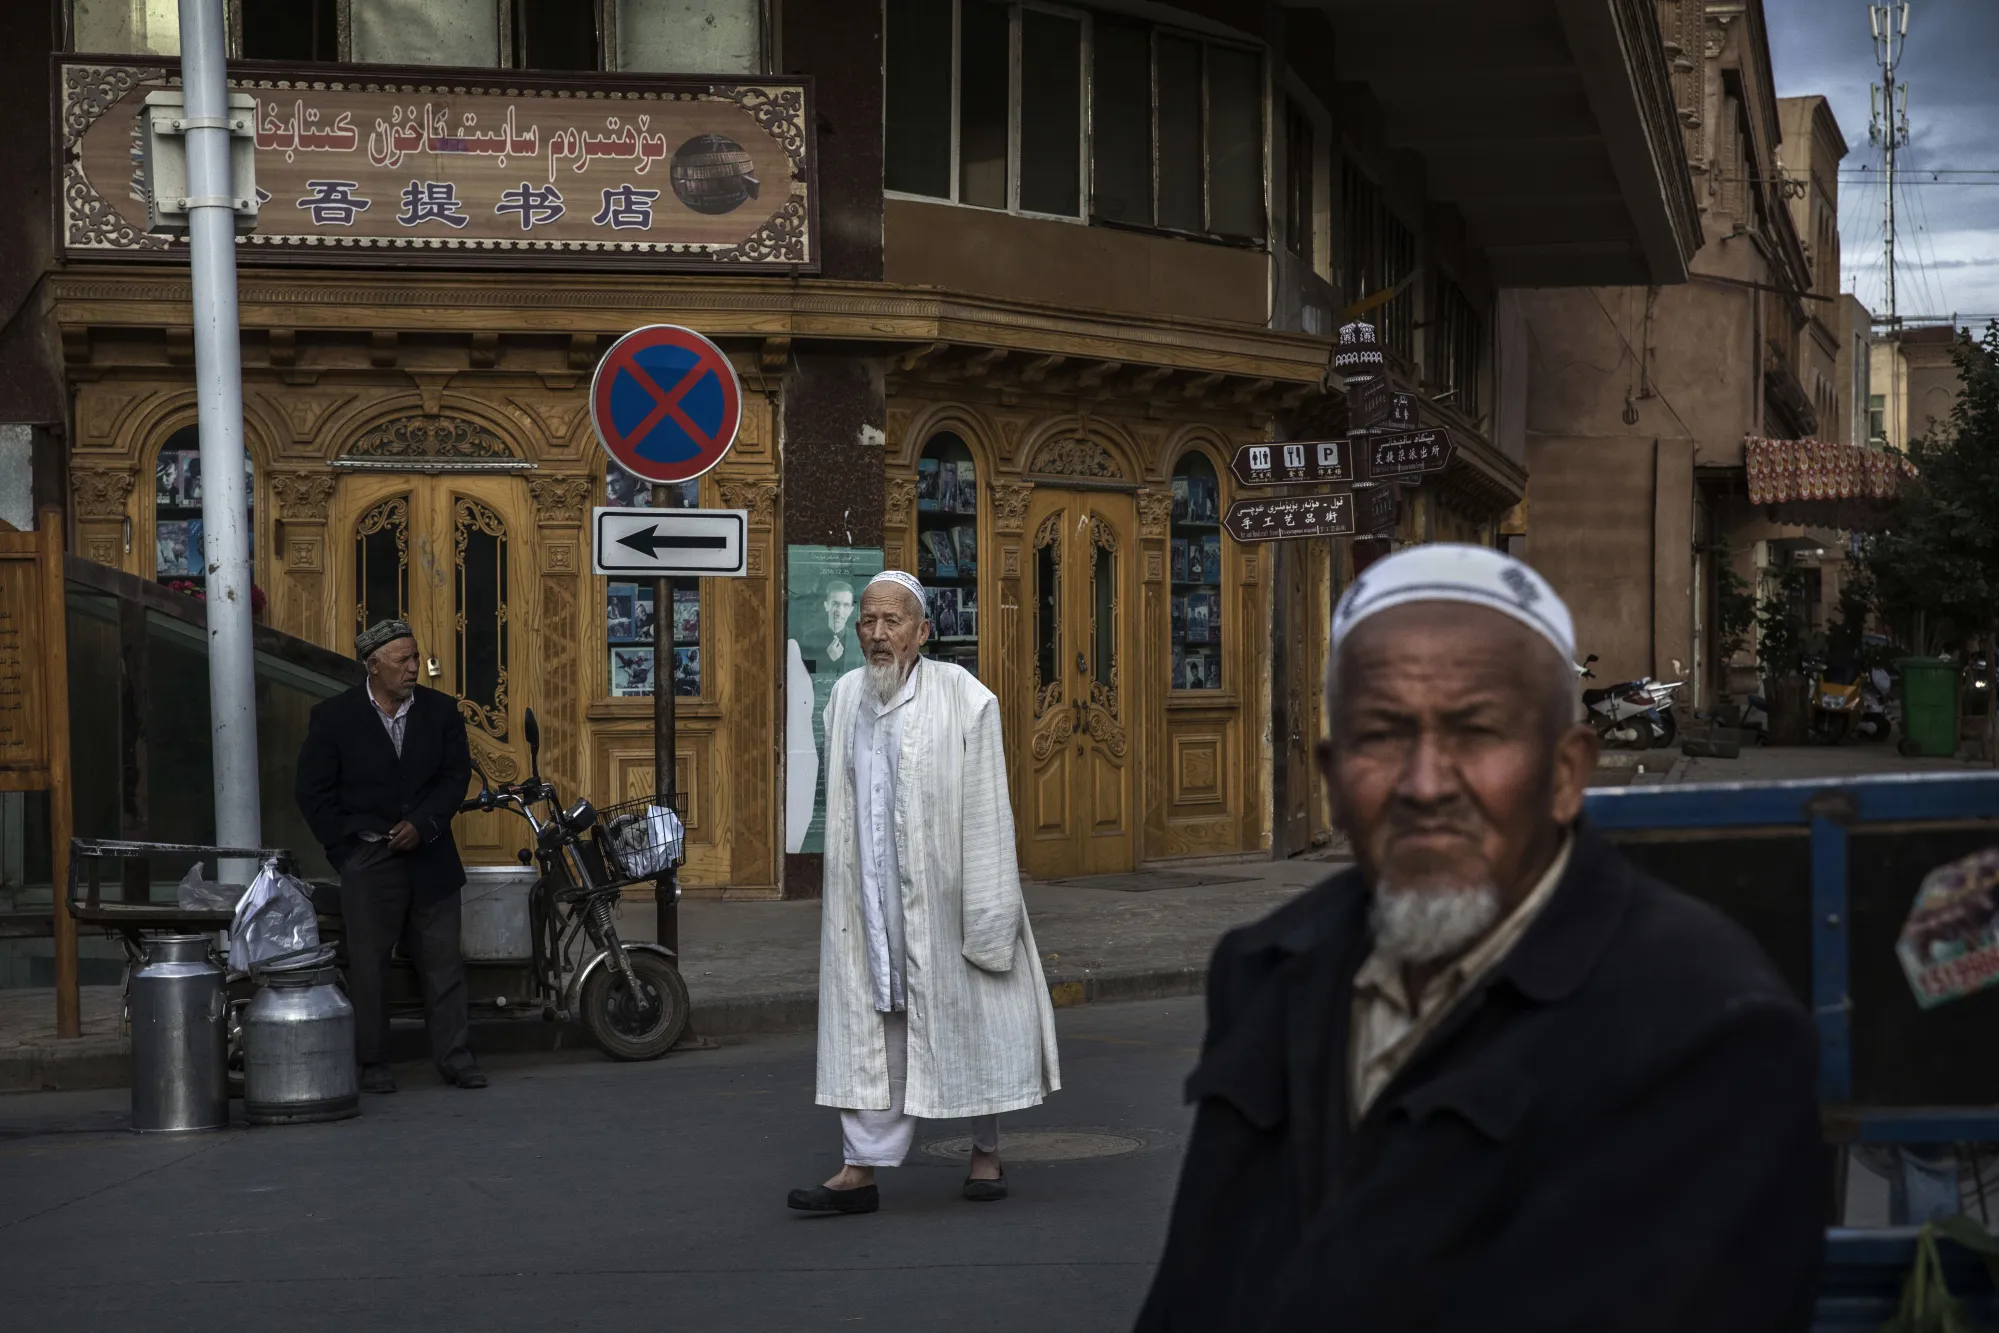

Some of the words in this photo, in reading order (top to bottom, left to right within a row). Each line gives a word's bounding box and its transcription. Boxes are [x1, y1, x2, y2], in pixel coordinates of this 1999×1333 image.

[254, 179, 660, 231] 吾提书店
[1241, 510, 1338, 530] 手工艺品街
